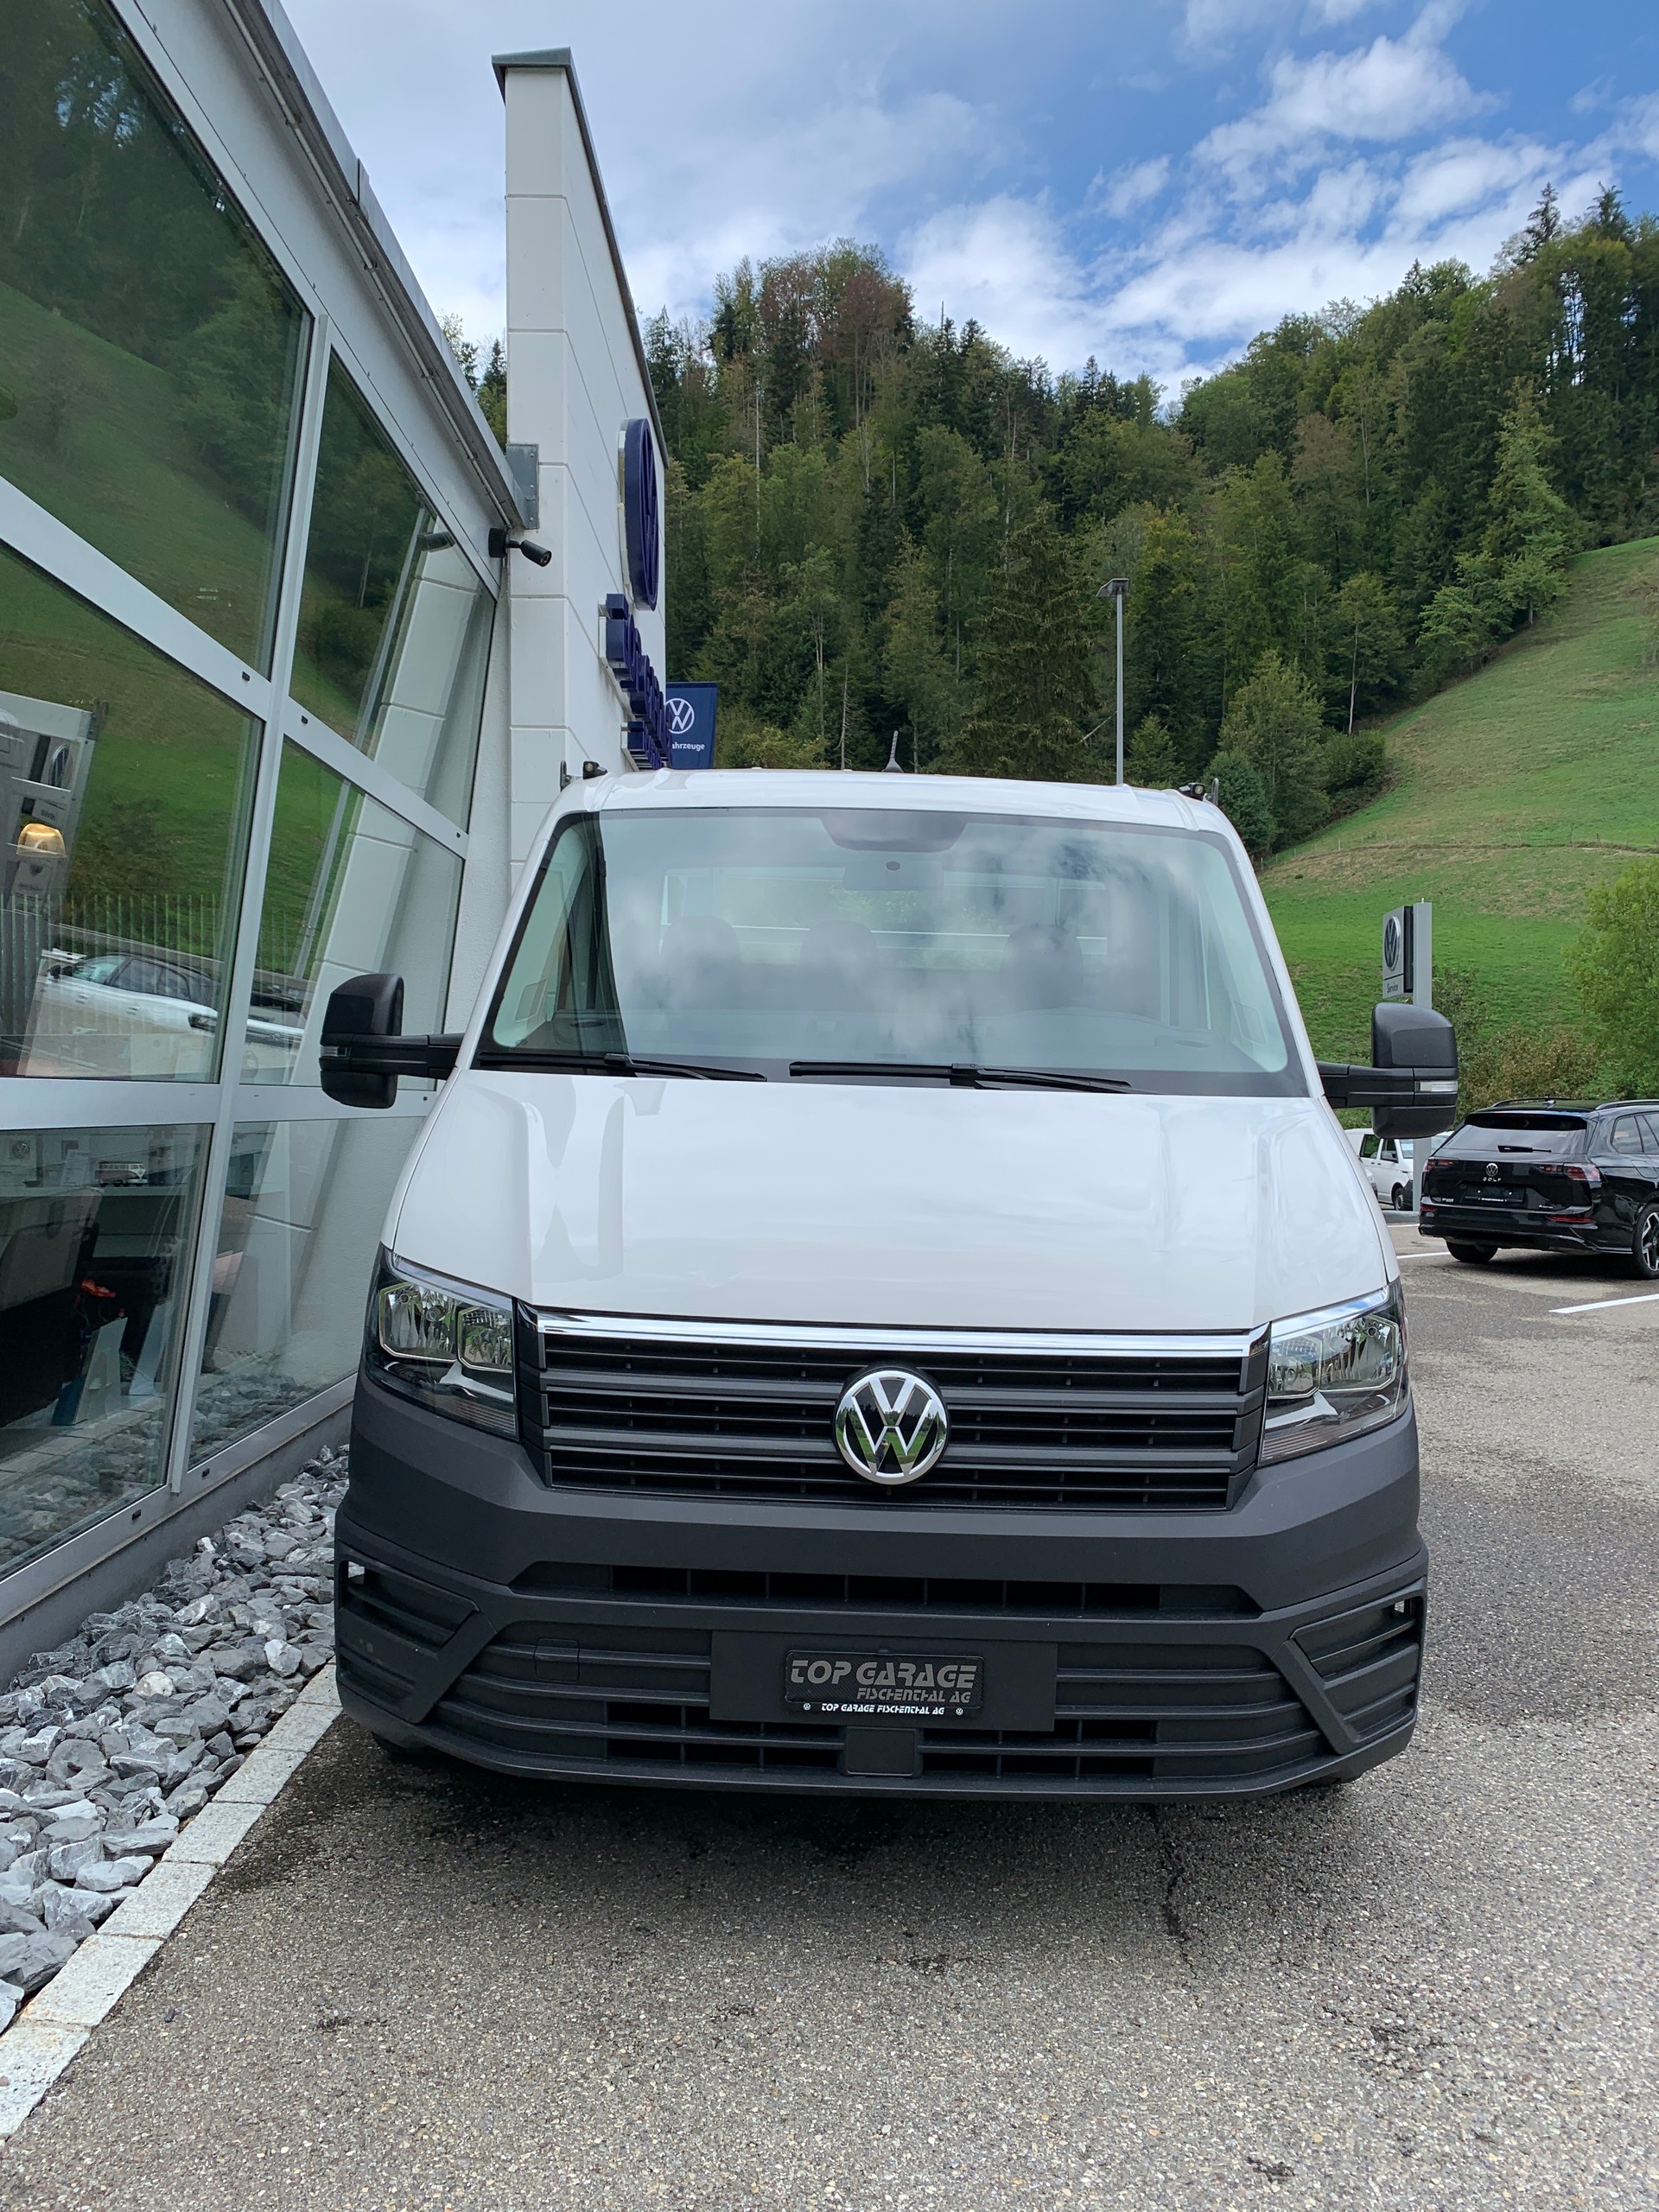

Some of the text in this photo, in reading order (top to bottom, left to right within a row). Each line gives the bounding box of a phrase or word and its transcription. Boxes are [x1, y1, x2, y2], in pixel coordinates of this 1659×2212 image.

[672, 741, 705, 752] ahrzeuge
[1387, 982, 1399, 994] Service
[791, 1660, 977, 1688] TOP GARAGE
[856, 1688, 971, 1703] FISCHENTHAL AG
[822, 1703, 839, 1712] TOP
[841, 1704, 874, 1713] GARAGE
[877, 1705, 930, 1715] FISCHENTHAL
[932, 1707, 944, 1715] AG
